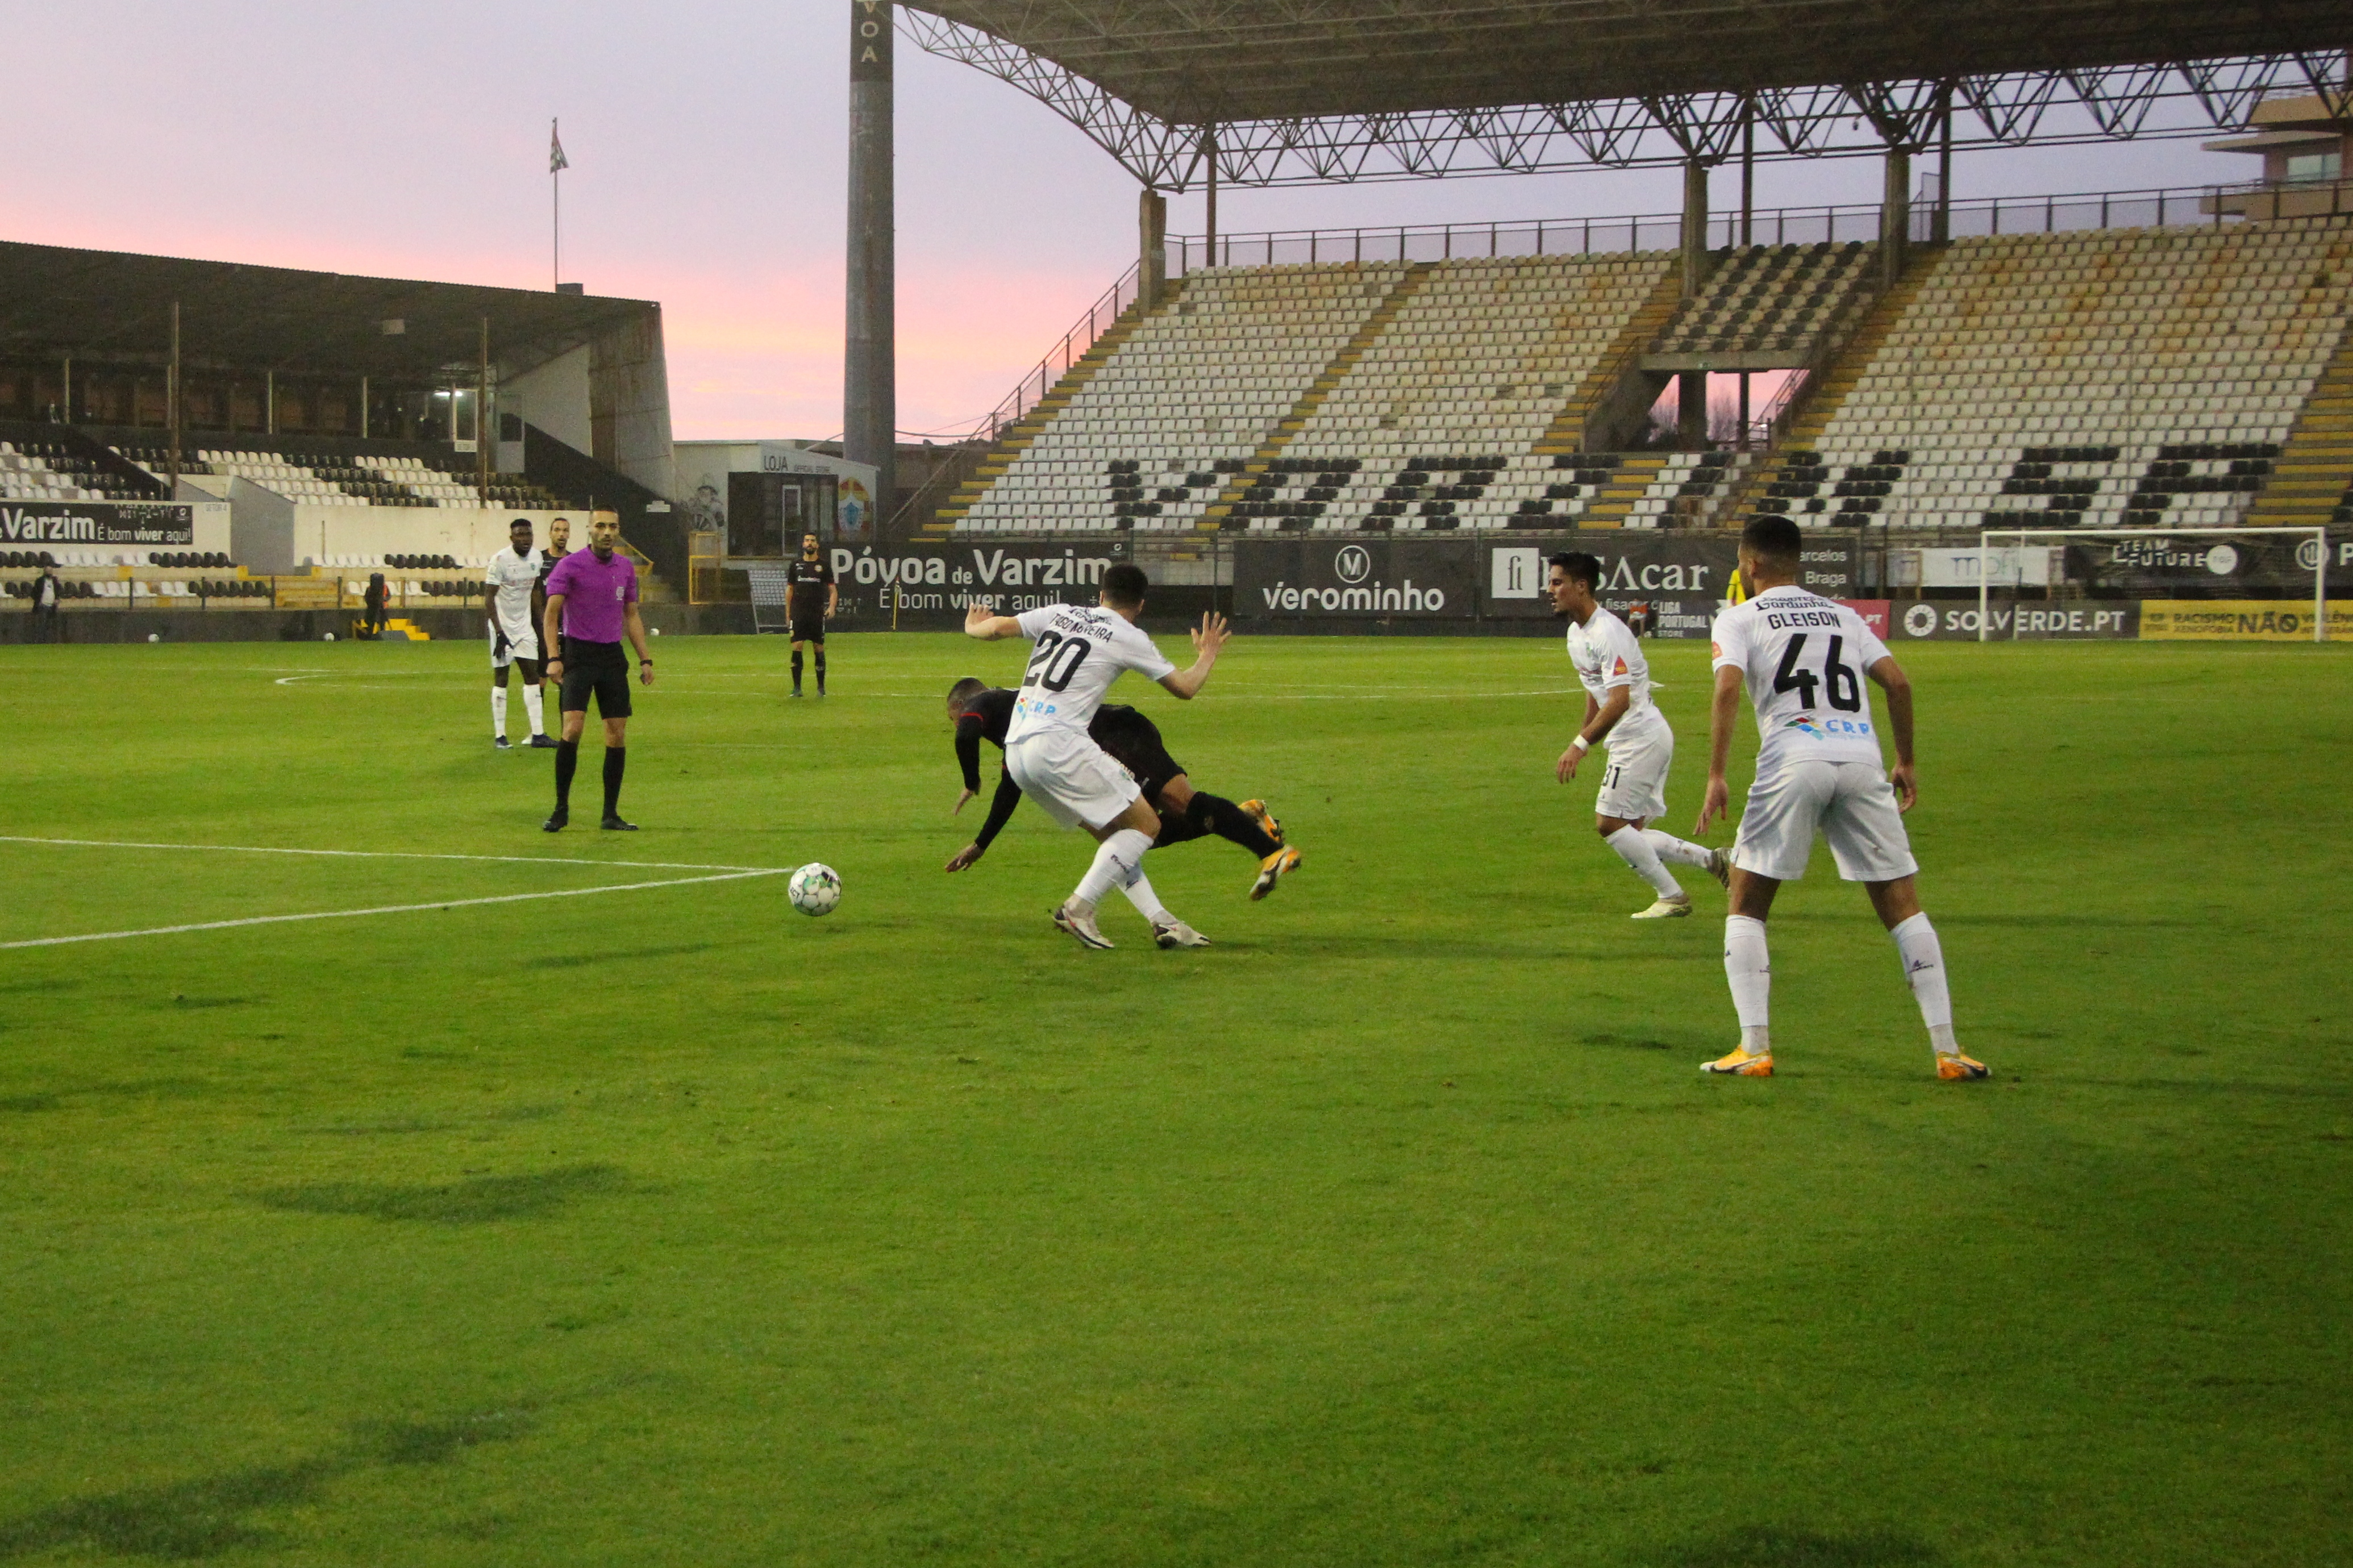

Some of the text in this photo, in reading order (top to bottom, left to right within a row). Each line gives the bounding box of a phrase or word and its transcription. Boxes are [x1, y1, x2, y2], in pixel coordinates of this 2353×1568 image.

[764, 454, 788, 472] LOJA
[2, 507, 95, 540] Varzim
[98, 523, 191, 544] É bom viver aqui!
[1799, 548, 1847, 562] arcelos
[2121, 539, 2170, 552] TEAM
[830, 545, 1112, 586] Póvoa de Varzim
[2128, 552, 2206, 567] FUTURE
[1805, 570, 1847, 587] Braga
[899, 589, 943, 609] bom
[949, 589, 1005, 610] viver
[1262, 579, 1445, 611] verominho
[1659, 601, 1681, 614] LIGA
[1658, 615, 1708, 628] PORTUGAL
[1767, 611, 1842, 630] GLEISON
[2238, 611, 2298, 633] NÃO
[1023, 629, 1092, 693] 20
[1773, 633, 1861, 713] 46
